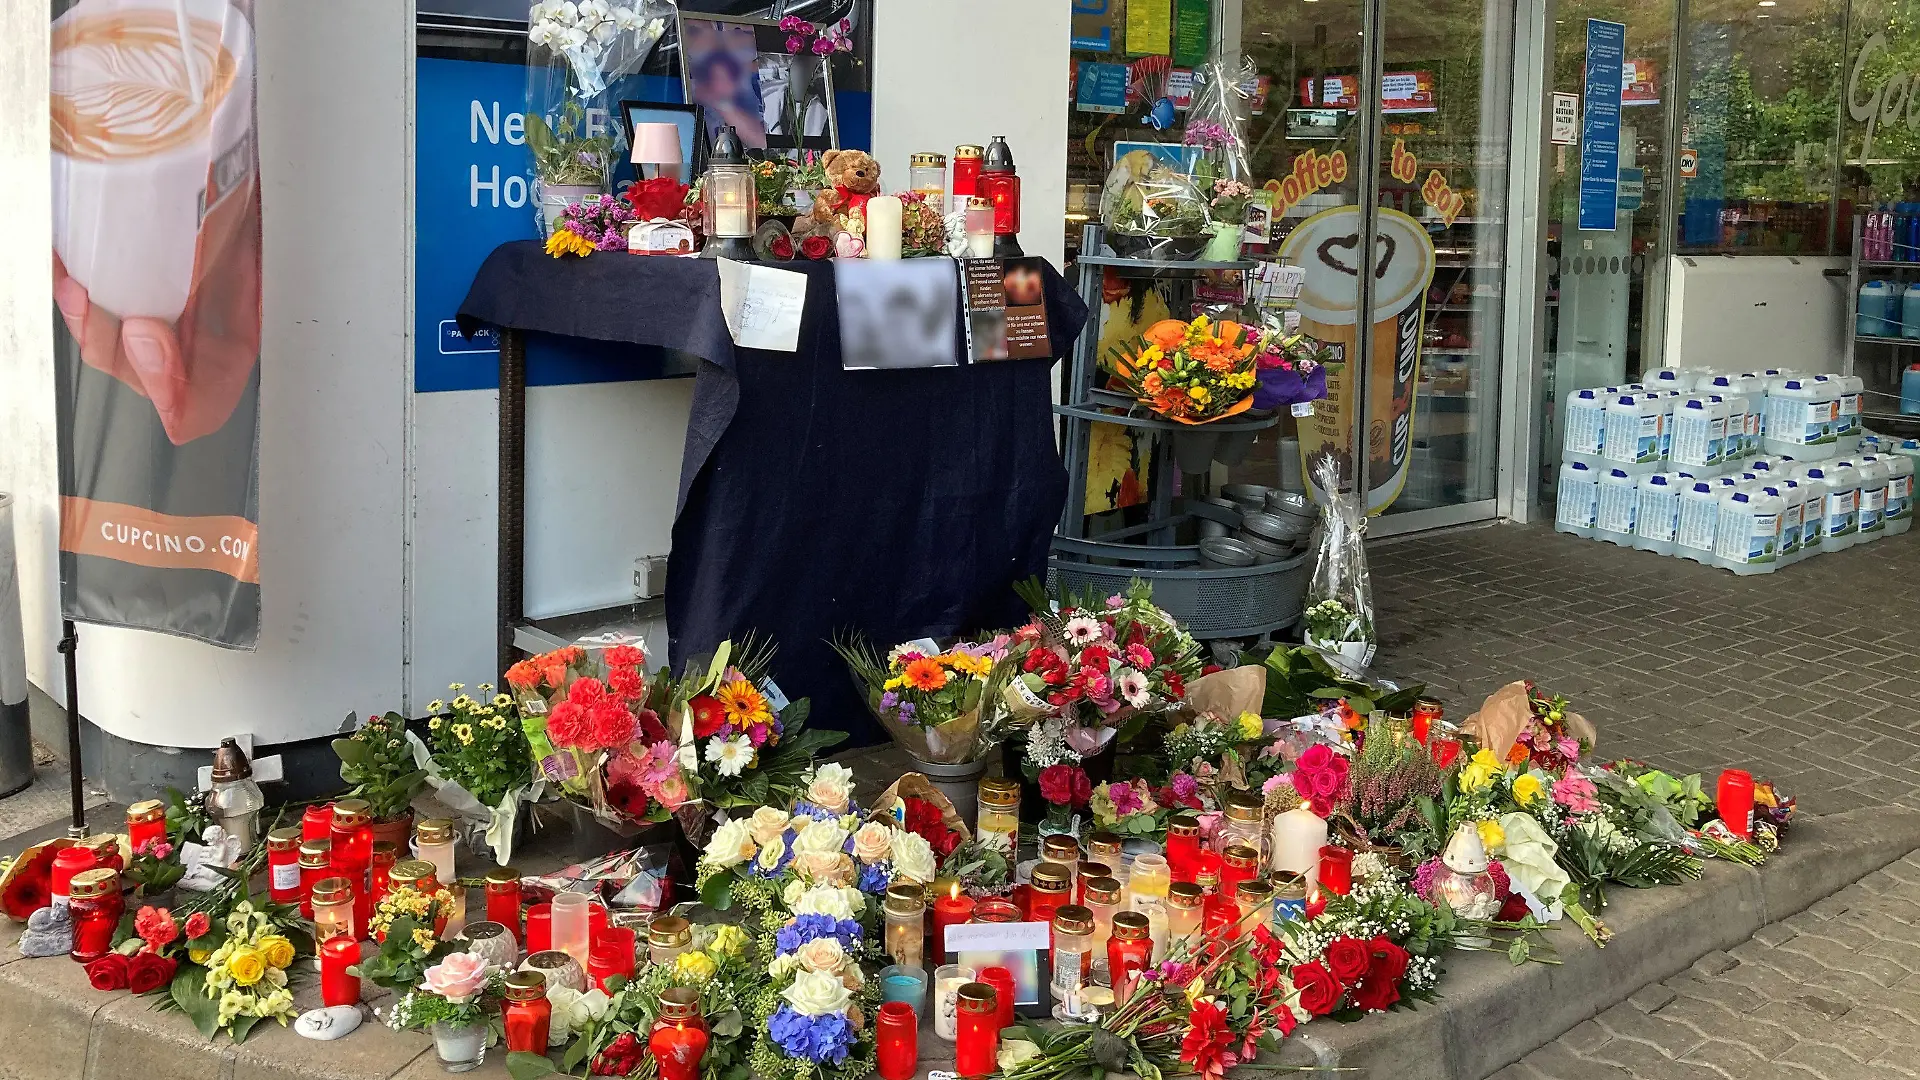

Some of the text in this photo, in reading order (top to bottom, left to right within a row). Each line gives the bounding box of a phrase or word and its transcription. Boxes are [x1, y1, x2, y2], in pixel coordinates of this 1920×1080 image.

[1681, 158, 1695, 168] DKV
[1263, 138, 1464, 228] Coffee to go!
[1270, 271, 1302, 284] HAPPY
[451, 329, 490, 338] PAACK
[1392, 308, 1419, 466] CUP CINO
